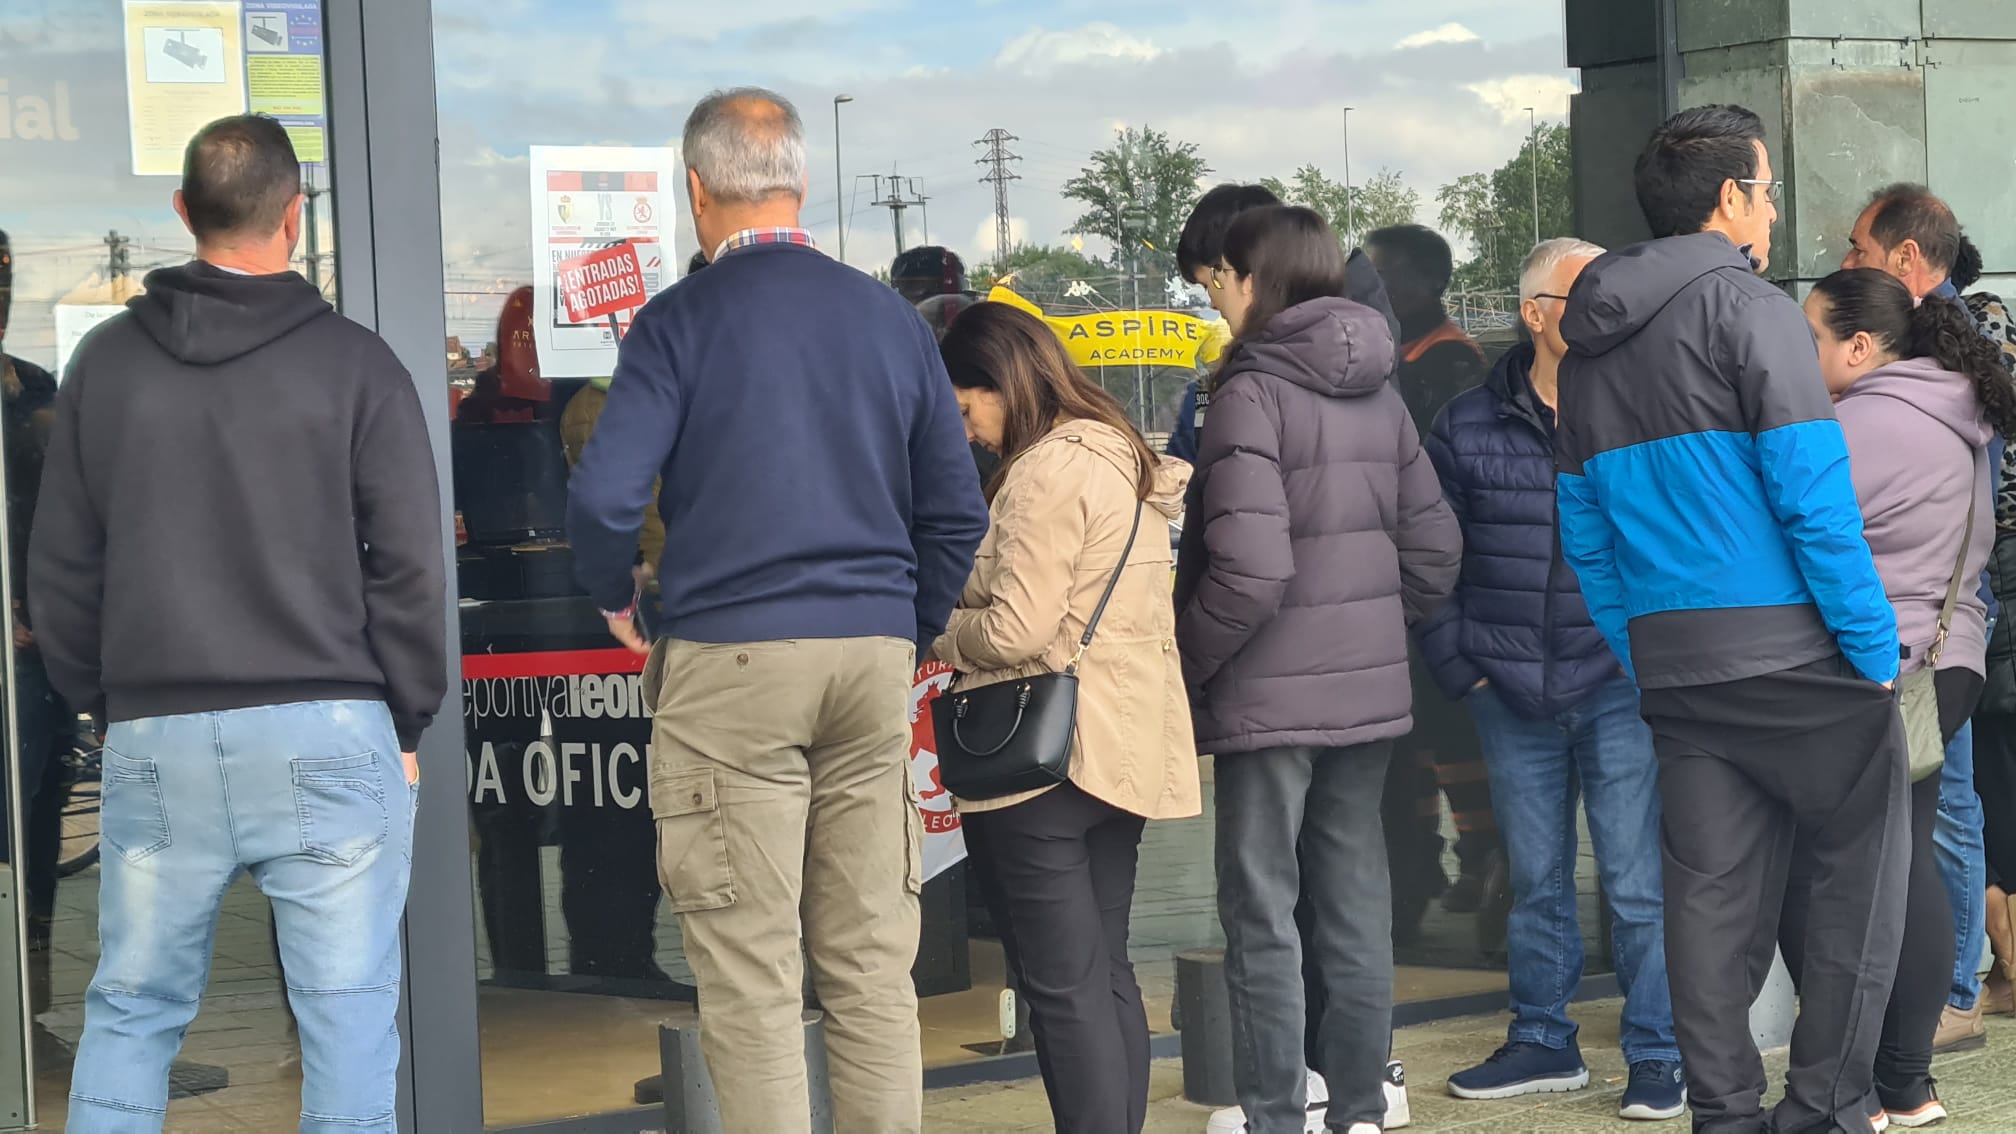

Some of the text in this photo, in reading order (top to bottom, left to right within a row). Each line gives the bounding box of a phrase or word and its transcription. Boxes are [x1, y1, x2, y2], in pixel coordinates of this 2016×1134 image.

[552, 250, 562, 262] EN
[566, 253, 635, 292] ¡ENTRADAS
[569, 273, 641, 313] AGOTADAS!
[1069, 316, 1198, 341] ASPIRE
[1090, 348, 1185, 360] ACADEMY
